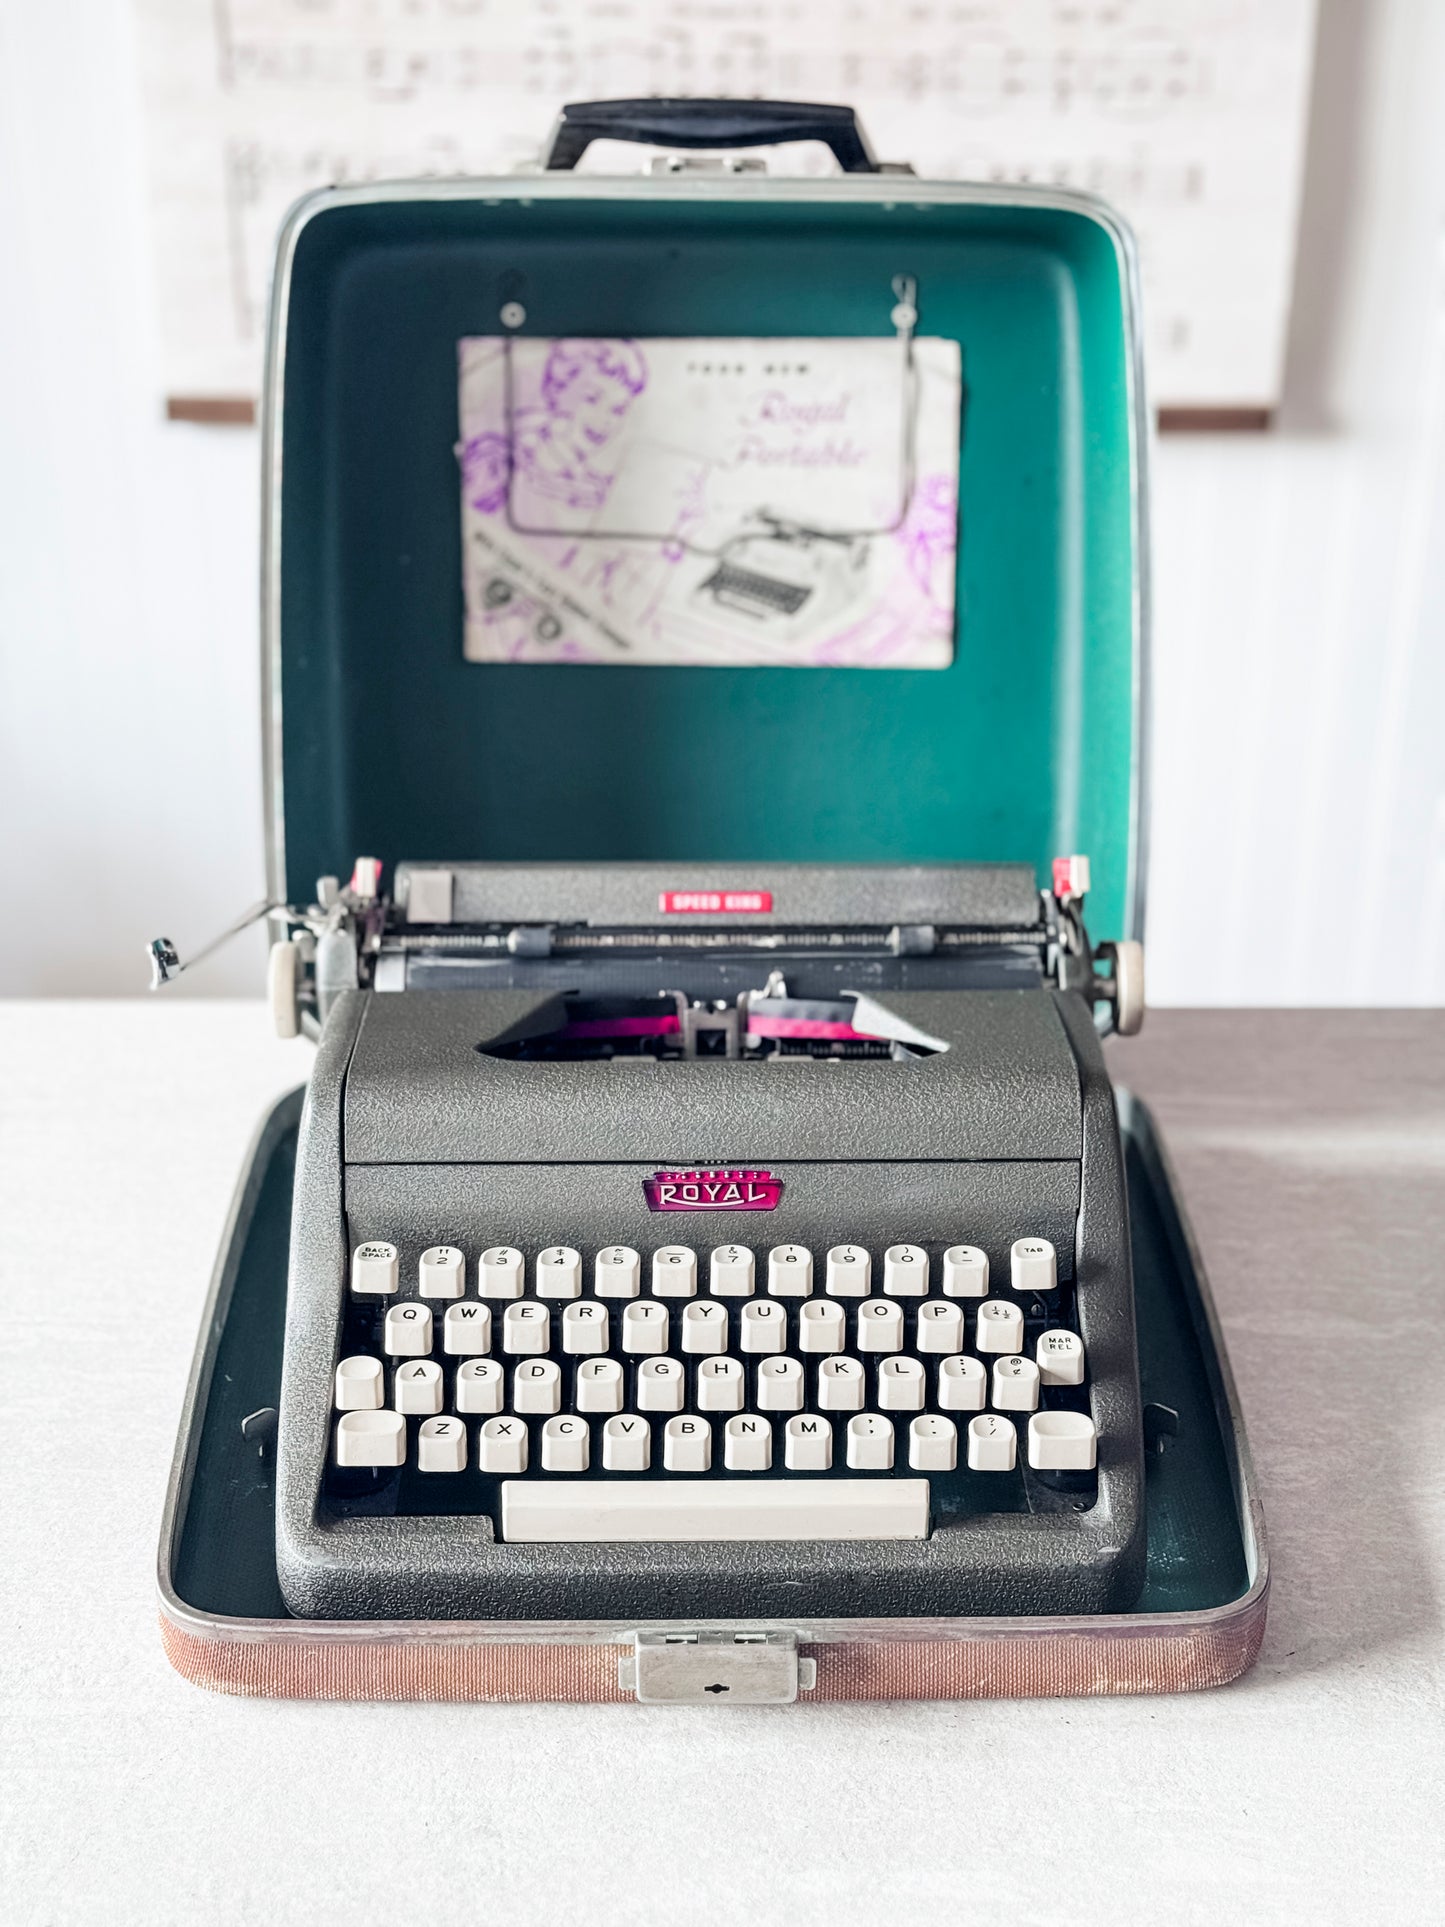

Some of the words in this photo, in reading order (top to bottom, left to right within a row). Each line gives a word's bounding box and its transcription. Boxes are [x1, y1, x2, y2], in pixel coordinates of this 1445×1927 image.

[659, 1183, 767, 1207] ROYAL
[360, 1251, 393, 1259] SPACE
[436, 1256, 448, 1265] 2
[612, 1256, 624, 1265] 5
[669, 1256, 682, 1264] 6
[728, 1255, 739, 1263] 7
[785, 1255, 798, 1263] 8
[843, 1255, 856, 1263] 9
[901, 1255, 914, 1263] 0
[495, 1257, 508, 1265] 3
[402, 1309, 417, 1320] Q
[460, 1308, 478, 1319] W
[520, 1307, 534, 1318] E
[579, 1307, 593, 1318] R
[640, 1307, 653, 1318] T
[699, 1307, 713, 1318] Y
[757, 1306, 771, 1317] U
[873, 1305, 889, 1316] O
[933, 1306, 948, 1317] P
[1049, 1343, 1073, 1351] REL
[412, 1367, 427, 1378] A
[474, 1365, 488, 1377] S
[531, 1365, 545, 1377] D
[594, 1364, 607, 1376] F
[654, 1363, 669, 1375] G
[714, 1363, 729, 1374] H
[775, 1363, 788, 1374] J
[834, 1363, 849, 1374] K
[894, 1362, 910, 1374] L
[434, 1423, 450, 1435] Z
[496, 1423, 512, 1435] X
[559, 1422, 573, 1434] C
[620, 1421, 635, 1433] V
[681, 1422, 696, 1434] B
[741, 1421, 756, 1433] N
[800, 1421, 817, 1433] M
